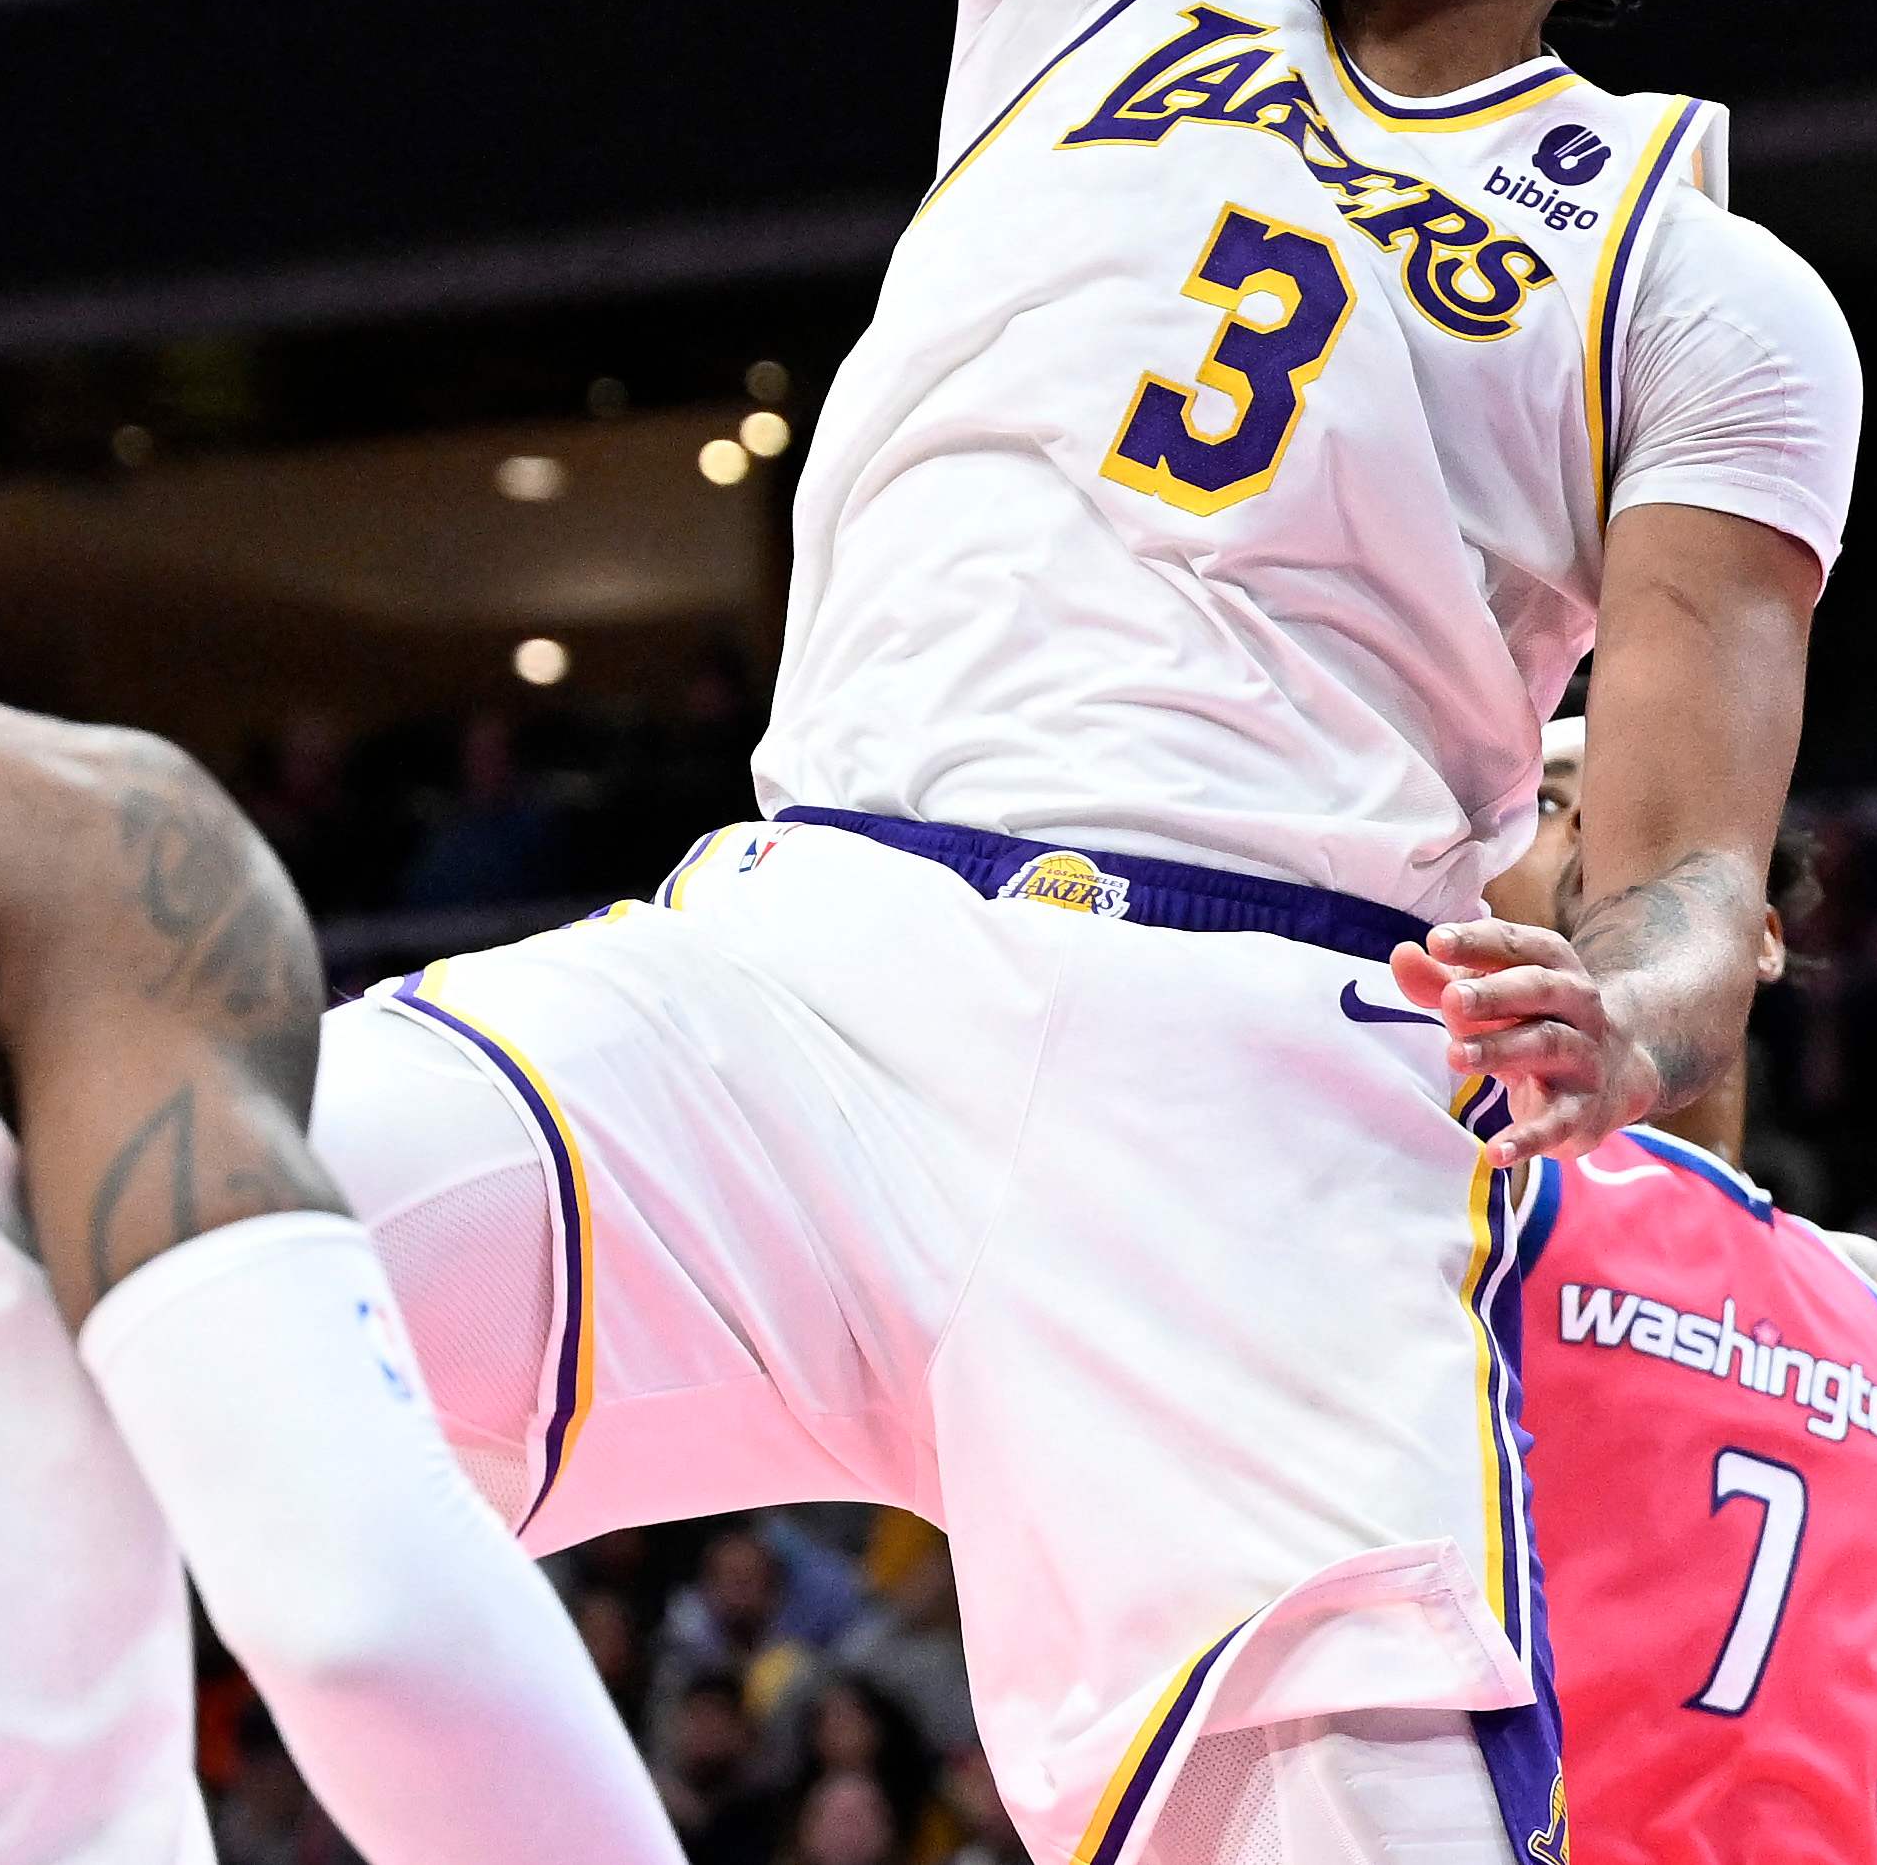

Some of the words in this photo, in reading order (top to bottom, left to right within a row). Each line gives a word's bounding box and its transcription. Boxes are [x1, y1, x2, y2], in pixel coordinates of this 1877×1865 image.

[1483, 165, 1599, 232] bibigo
[1098, 200, 1359, 517] 3
[1002, 865, 1121, 914] LAKERS
[1046, 868, 1067, 876] LOS
[1068, 873, 1125, 889] ANGELES
[1681, 1446, 1809, 1718] 7
